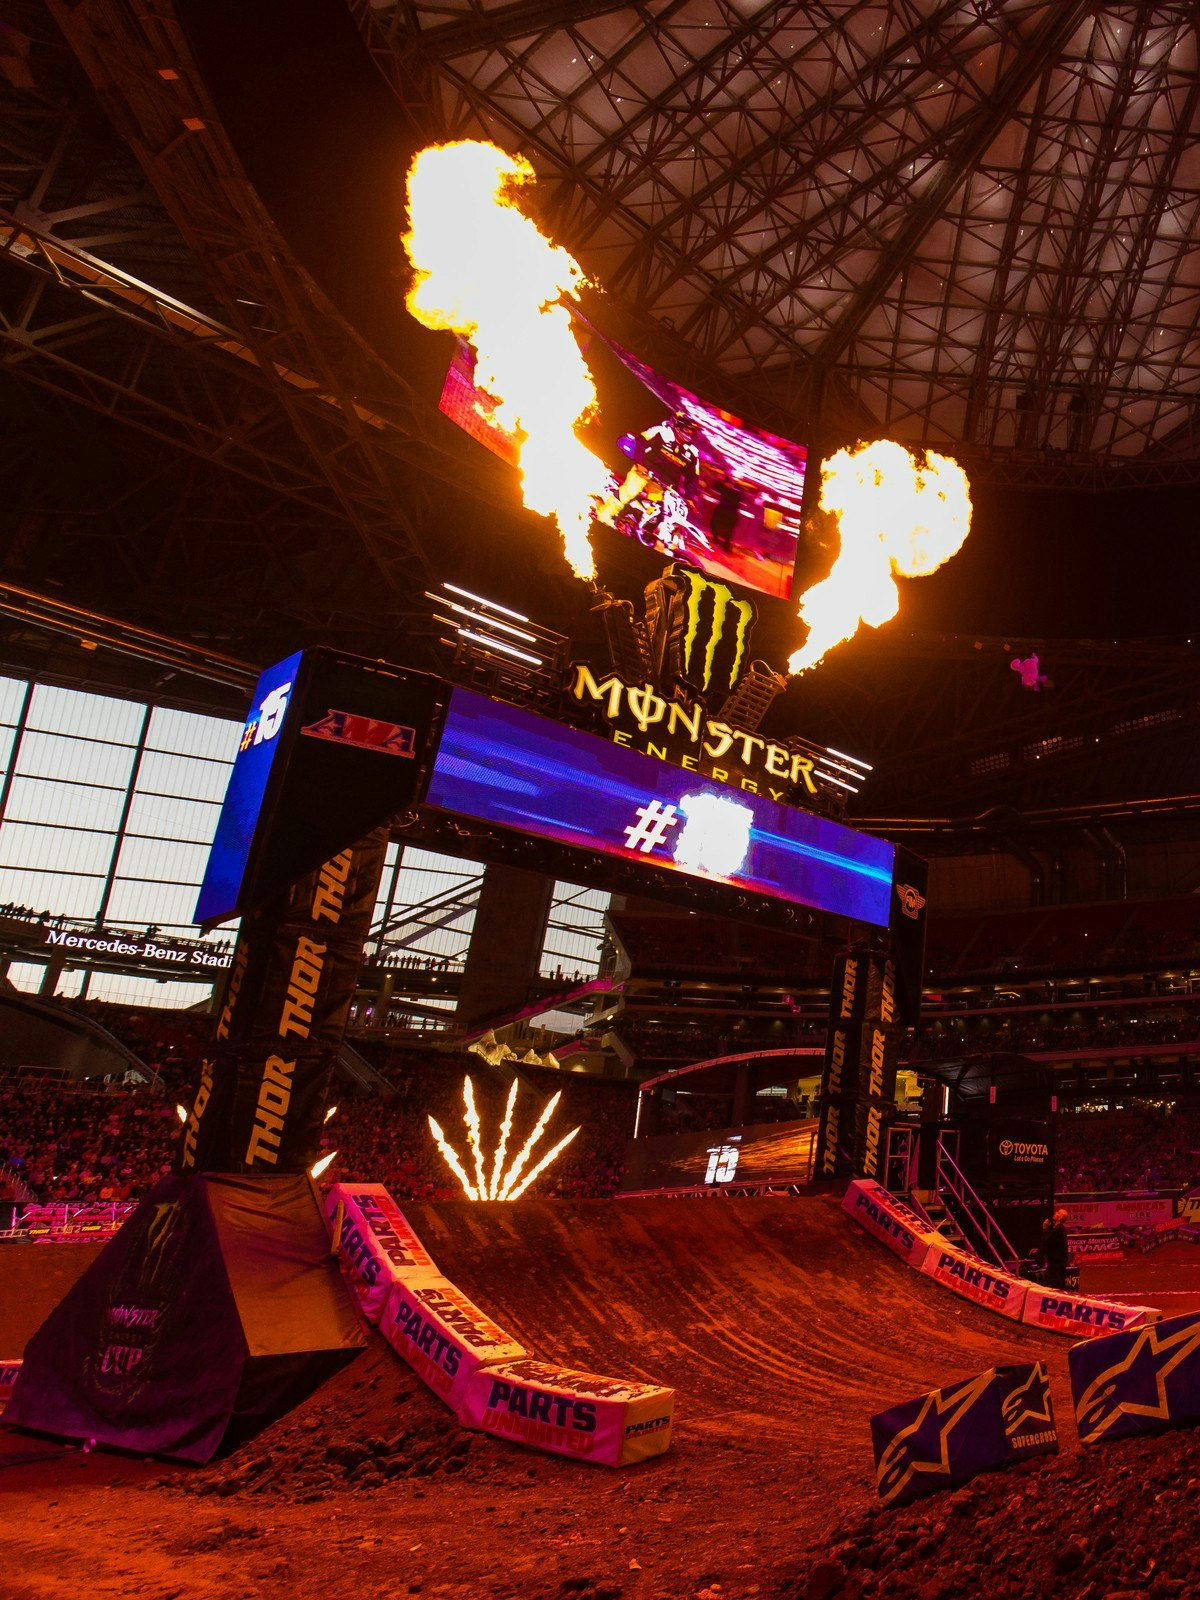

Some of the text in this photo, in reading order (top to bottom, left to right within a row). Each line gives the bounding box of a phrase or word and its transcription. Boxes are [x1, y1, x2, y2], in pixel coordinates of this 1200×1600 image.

[306, 712, 414, 755] AMA
[573, 665, 818, 794] MONSTER
[613, 730, 784, 801] ENERGY
[311, 848, 353, 924] THO
[44, 929, 235, 969] Mercedes-Benz Stadi
[278, 935, 328, 1040] THOR
[840, 958, 858, 1020] THOR
[880, 958, 897, 1024] THOR
[828, 1029, 847, 1095] THOR
[869, 1028, 887, 1097] THOR
[182, 1057, 217, 1170] THOR
[245, 1054, 298, 1166] THOR
[823, 1105, 842, 1176] THOR
[863, 1106, 883, 1176] THOR
[1013, 1142, 1049, 1156] TOYOTA
[352, 1195, 417, 1267] PARTS
[855, 1193, 916, 1251] PARTS
[938, 1252, 1011, 1299] PARTS
[394, 1299, 463, 1377] PARTS
[413, 1289, 498, 1347] PARTS
[1040, 1296, 1126, 1331] PARTS
[481, 1407, 596, 1454] UNLIMITED
[488, 1380, 597, 1433] PARTS
[625, 1415, 671, 1435] PARTS
[1011, 1430, 1058, 1449] SUPERCROSS
